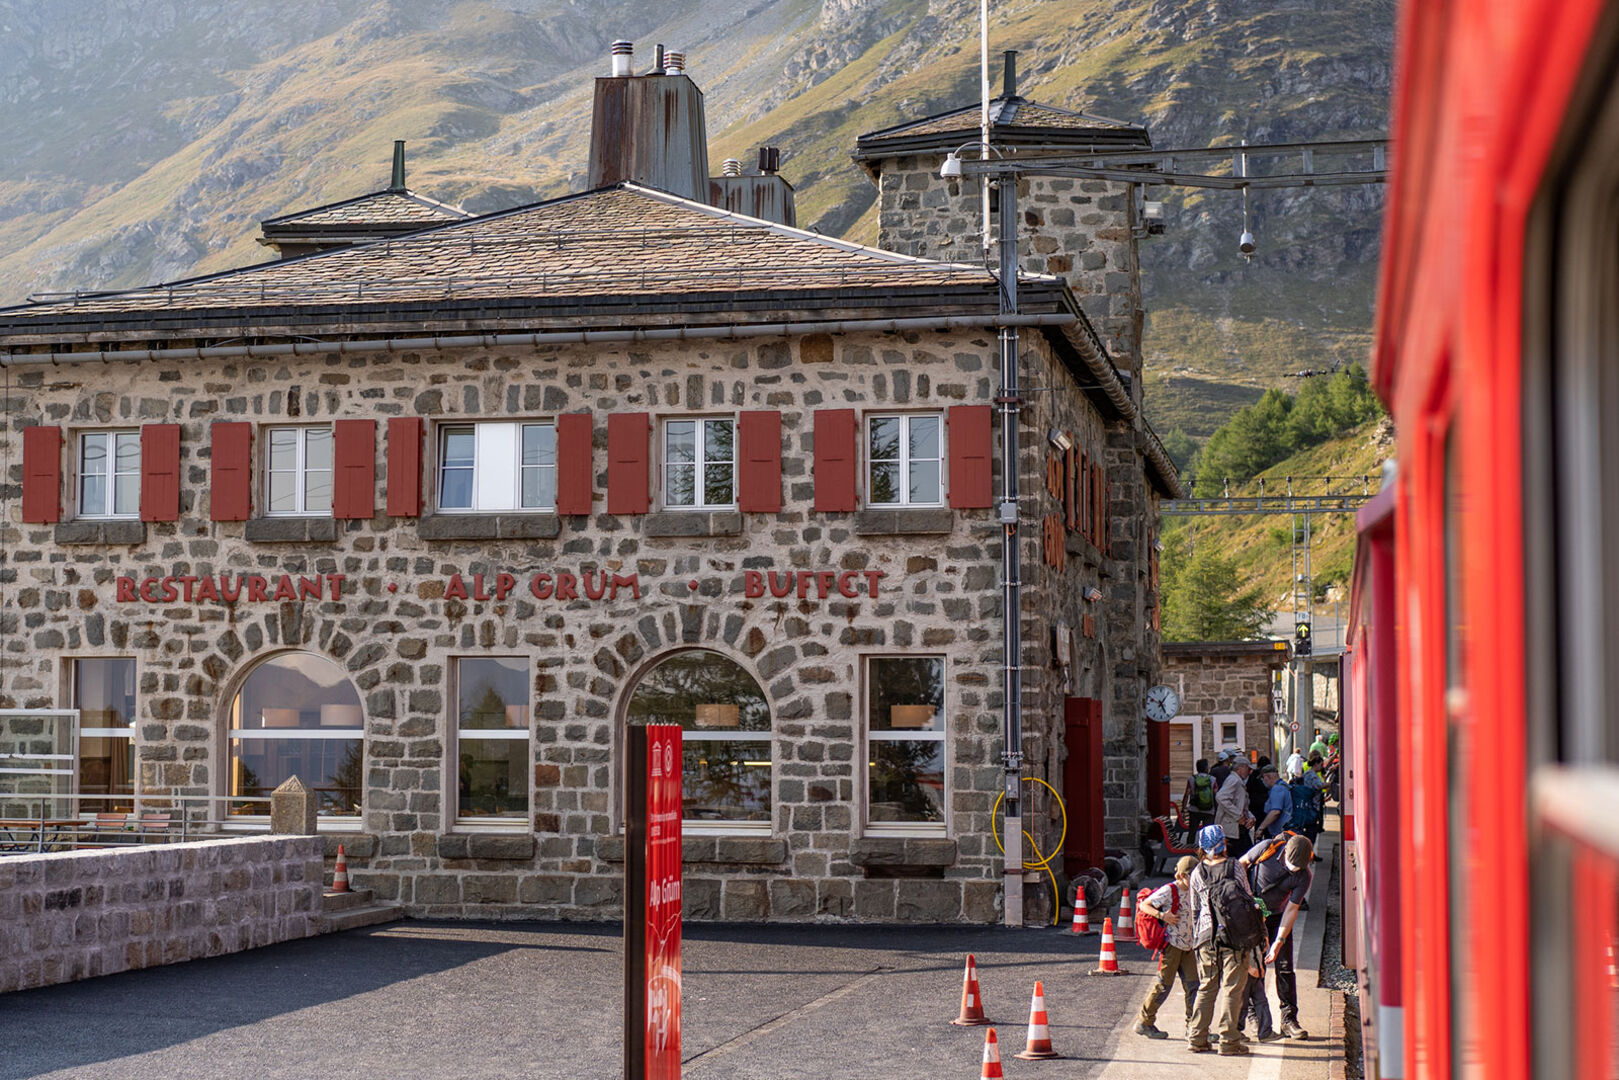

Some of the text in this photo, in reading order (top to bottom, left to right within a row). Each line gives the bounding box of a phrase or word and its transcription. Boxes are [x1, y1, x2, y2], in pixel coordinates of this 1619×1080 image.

[117, 569, 884, 602] RESTAURANT ALP GRÜM BUFFET
[649, 875, 681, 911] Alp Grüm
